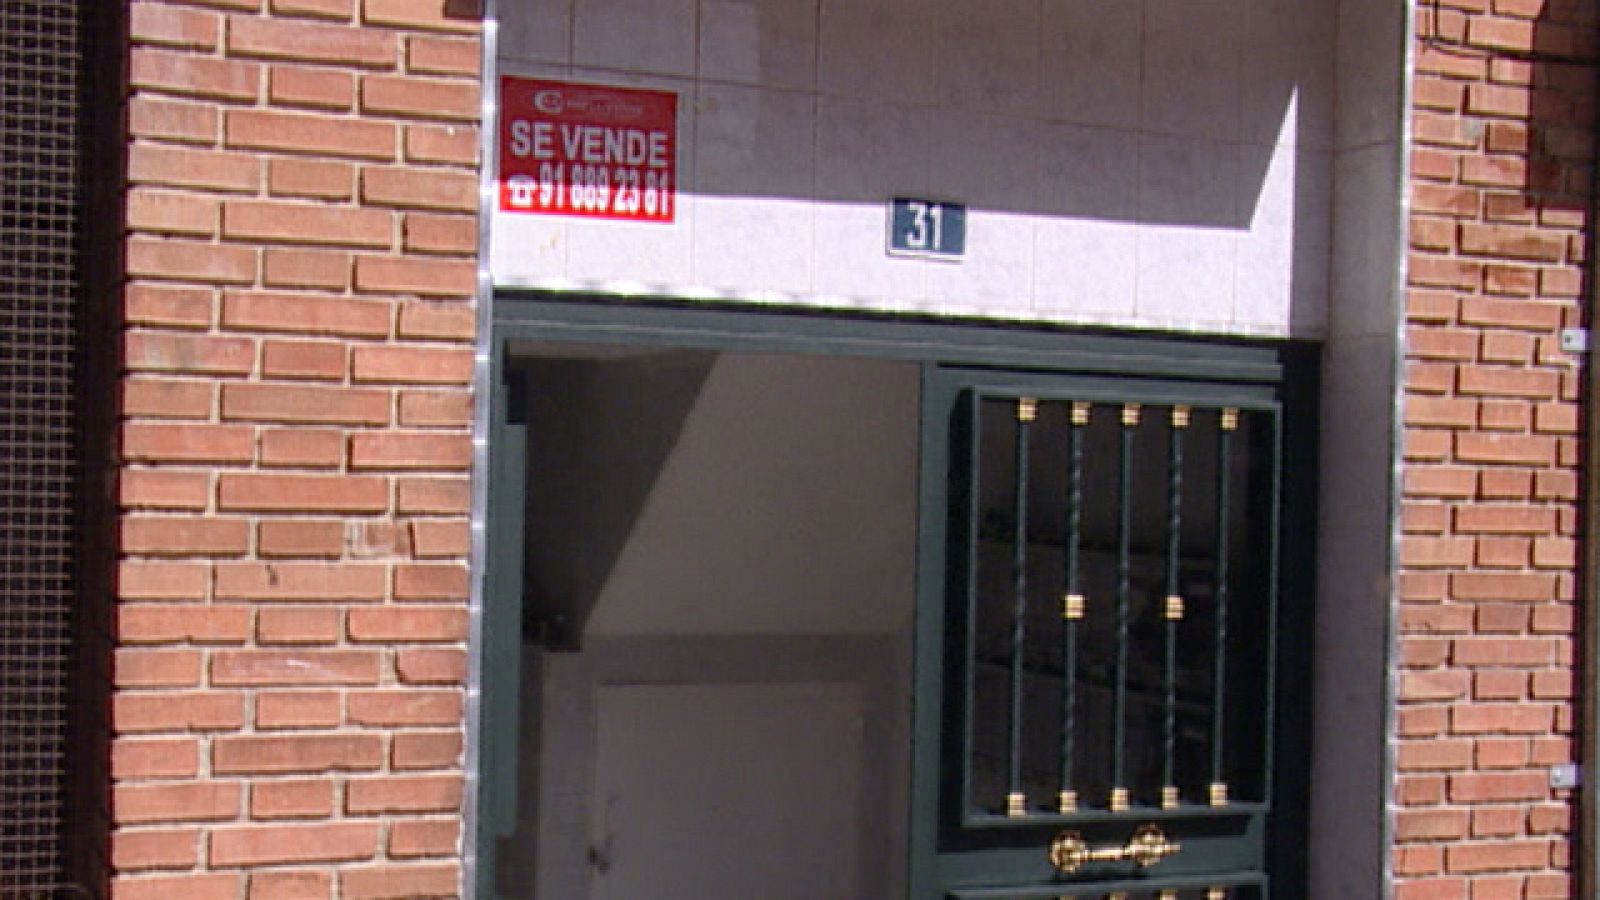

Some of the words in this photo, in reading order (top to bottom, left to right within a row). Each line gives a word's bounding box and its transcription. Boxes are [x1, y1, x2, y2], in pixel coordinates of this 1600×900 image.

[511, 119, 553, 158] SE
[560, 123, 668, 167] VENDE
[539, 161, 563, 209] 91
[614, 168, 639, 215] 23
[906, 202, 943, 250] 31
